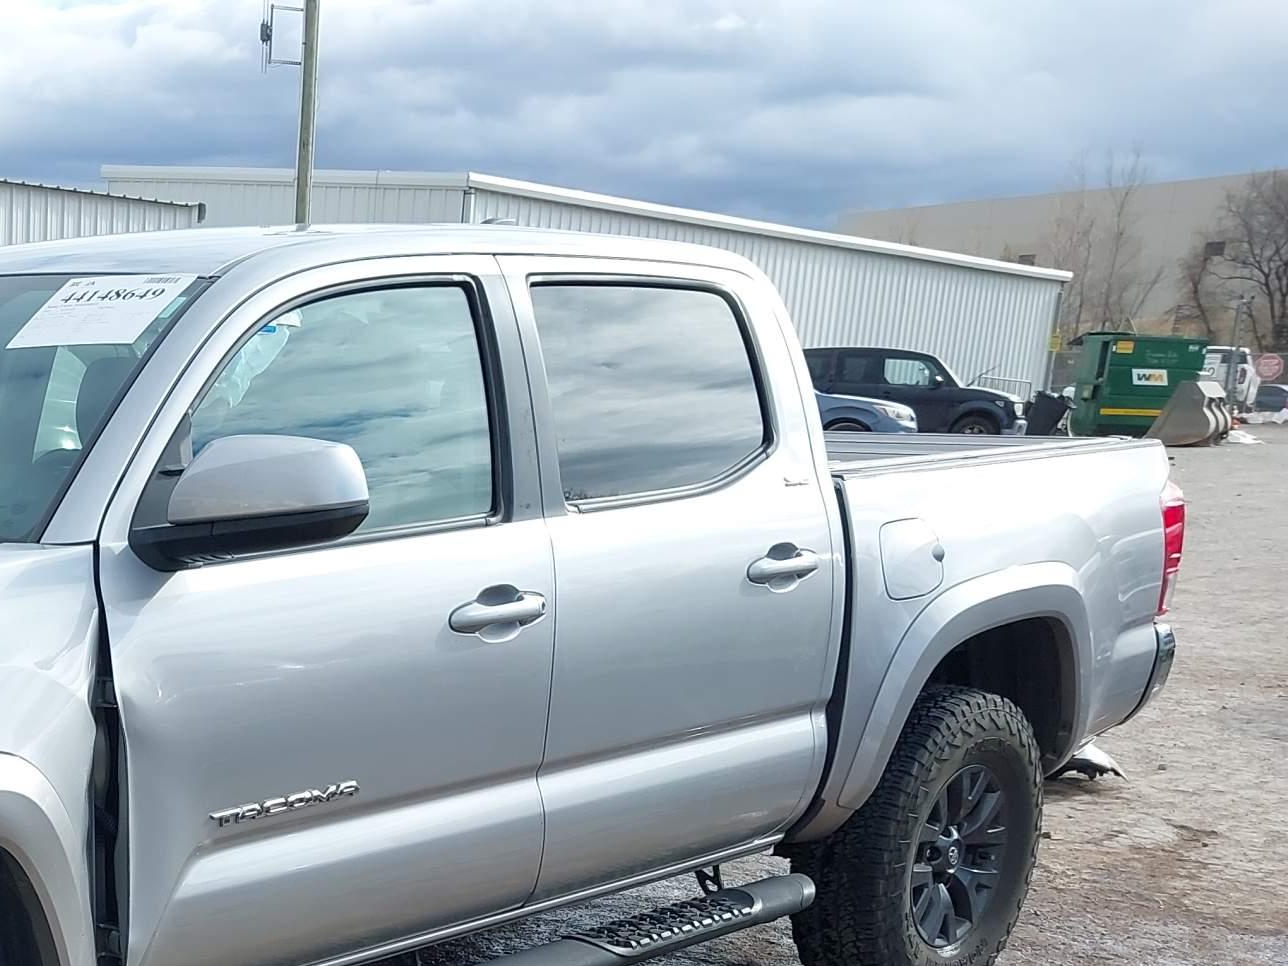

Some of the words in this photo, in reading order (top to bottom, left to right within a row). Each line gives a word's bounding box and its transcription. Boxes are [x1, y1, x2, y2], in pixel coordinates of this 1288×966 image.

[59, 286, 167, 304] 44148649
[1136, 372, 1164, 382] WM
[208, 779, 361, 828] TACOMA
